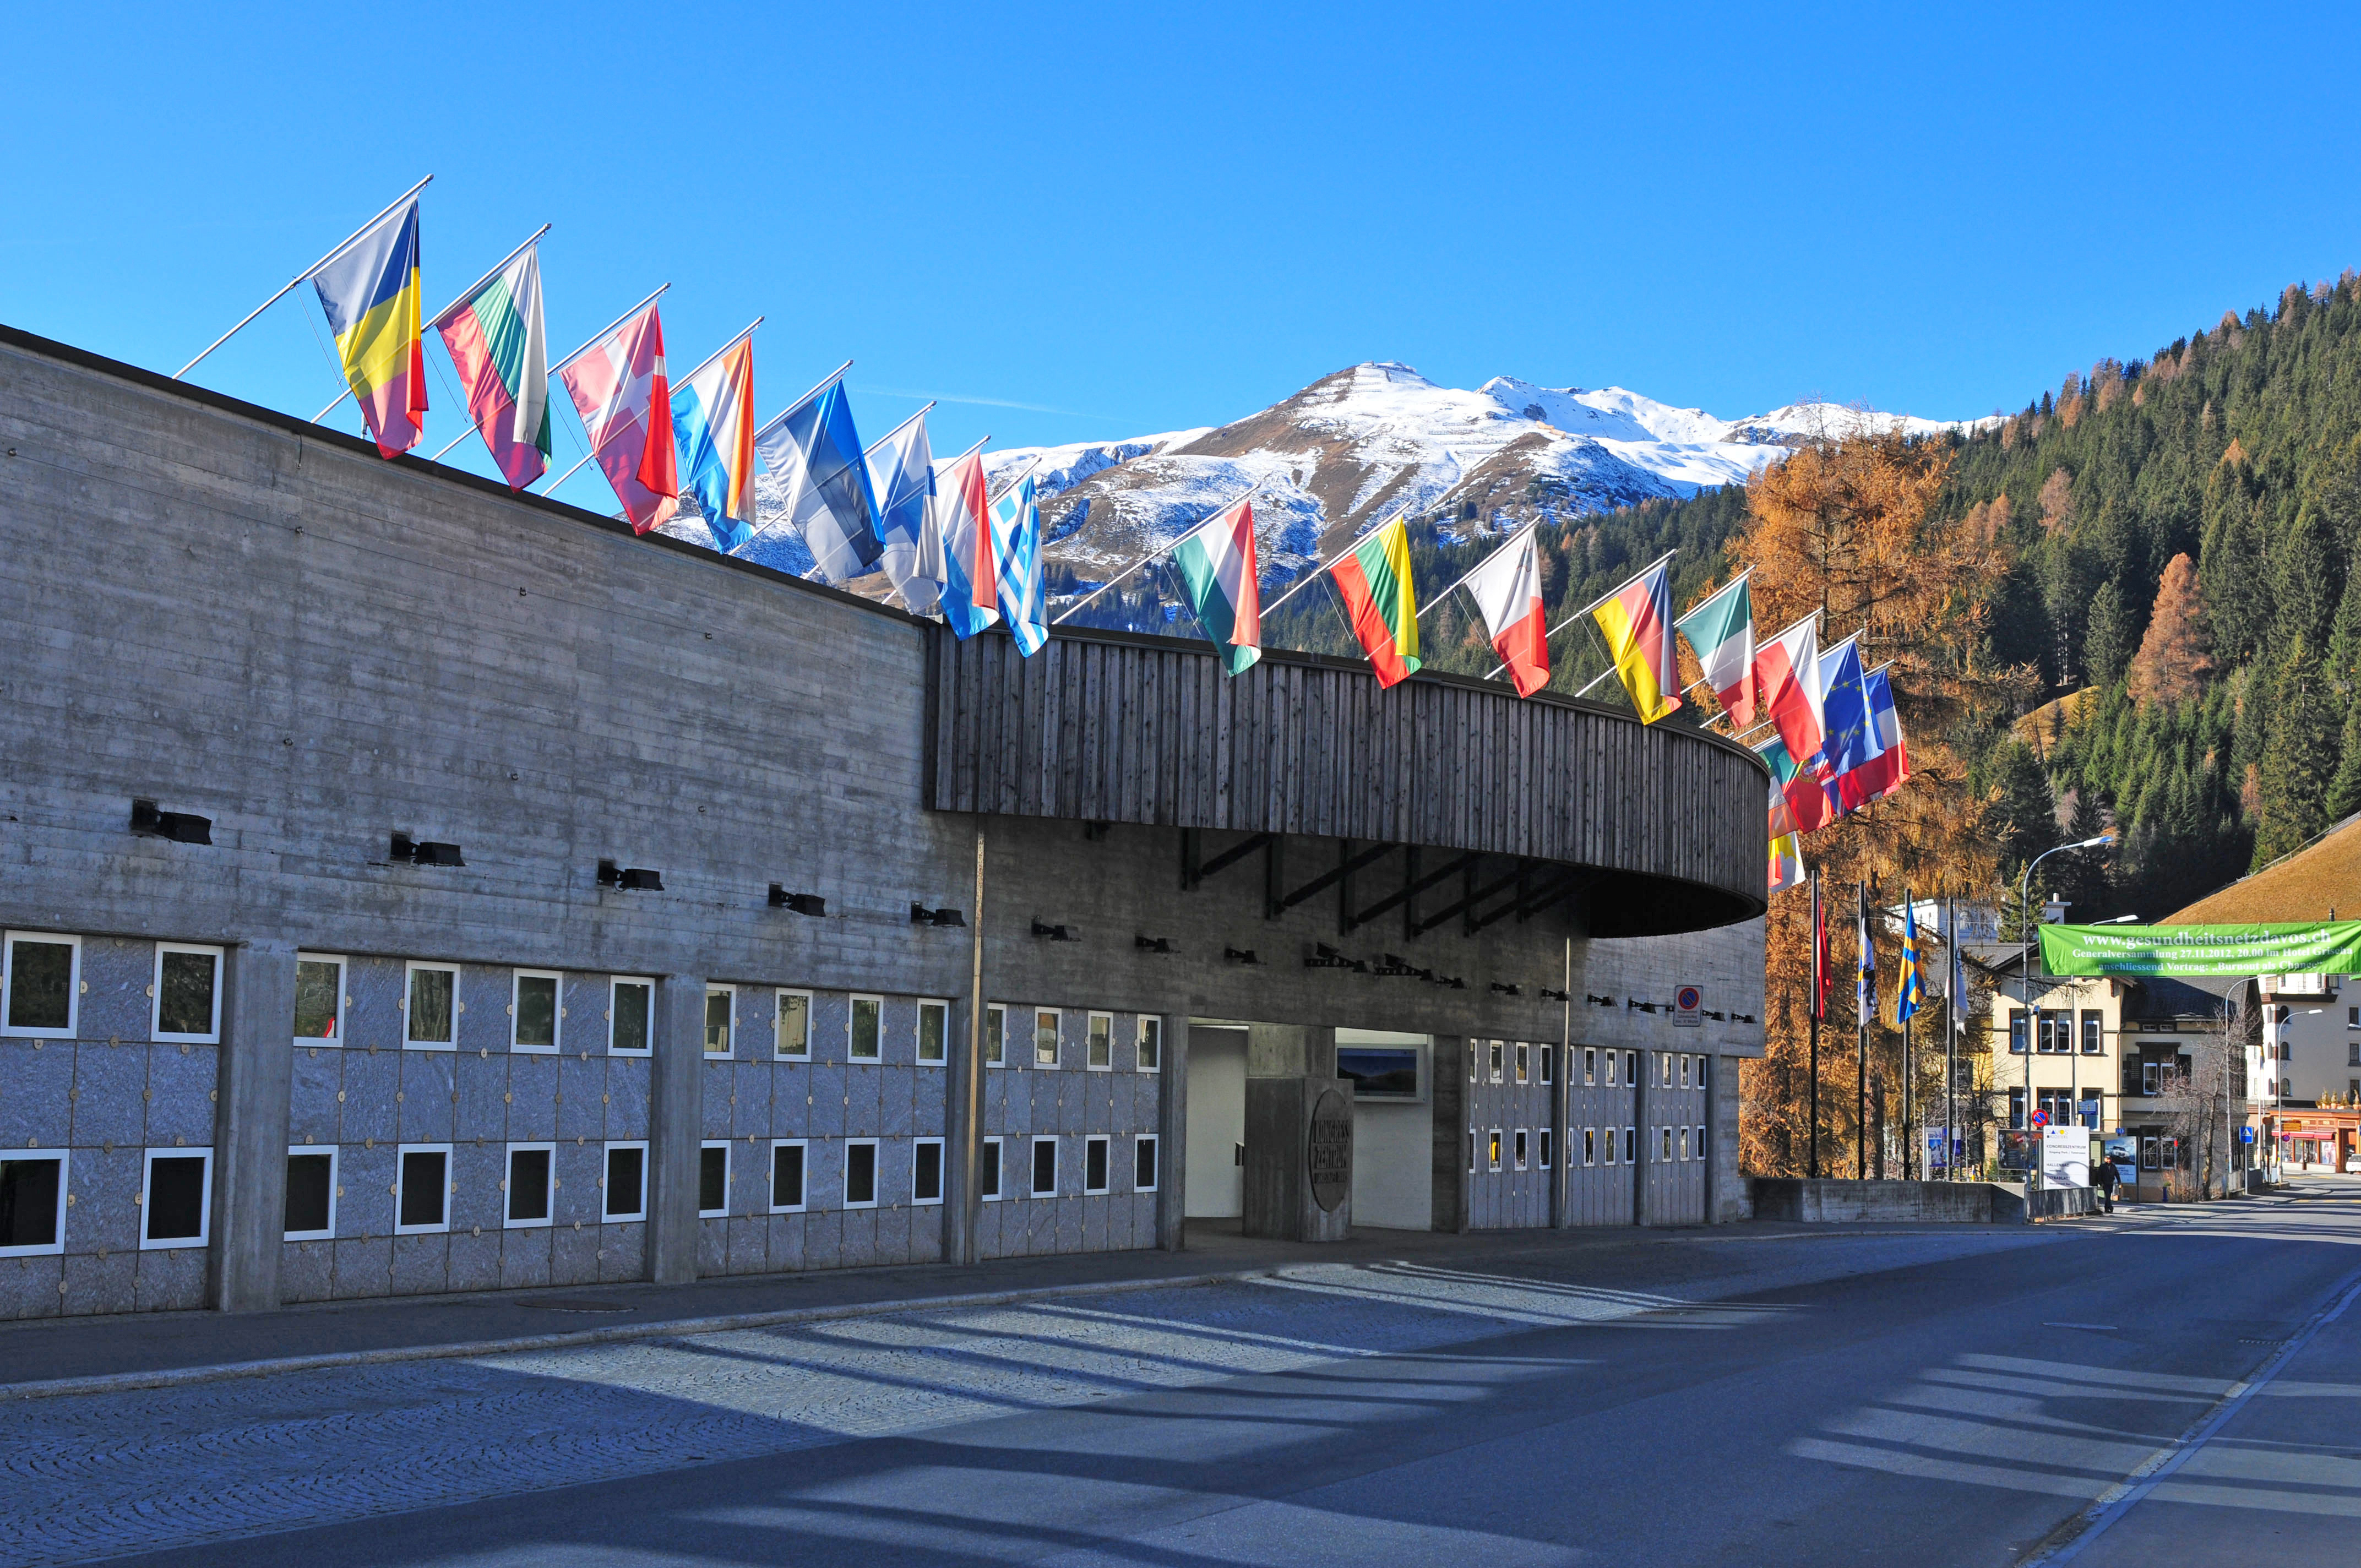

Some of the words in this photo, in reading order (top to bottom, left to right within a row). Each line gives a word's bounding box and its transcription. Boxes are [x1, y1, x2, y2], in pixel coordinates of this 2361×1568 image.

[2083, 929, 2331, 950] www.gesundheitsnetzdavos.ch
[2072, 949, 2178, 960] Generalversammlung
[2180, 949, 2235, 959] 27.11.2012,
[2237, 949, 2264, 957] 20.00
[2266, 948, 2279, 957] im
[2283, 948, 2310, 956] Hotel
[2313, 946, 2353, 955] Grischa
[2099, 962, 2164, 971] anschliessend
[2167, 962, 2209, 973] Vortrag:
[2262, 961, 2276, 970] als
[1314, 1119, 1349, 1144] KONGRESS
[1315, 1144, 1347, 1169] ZENTRUM
